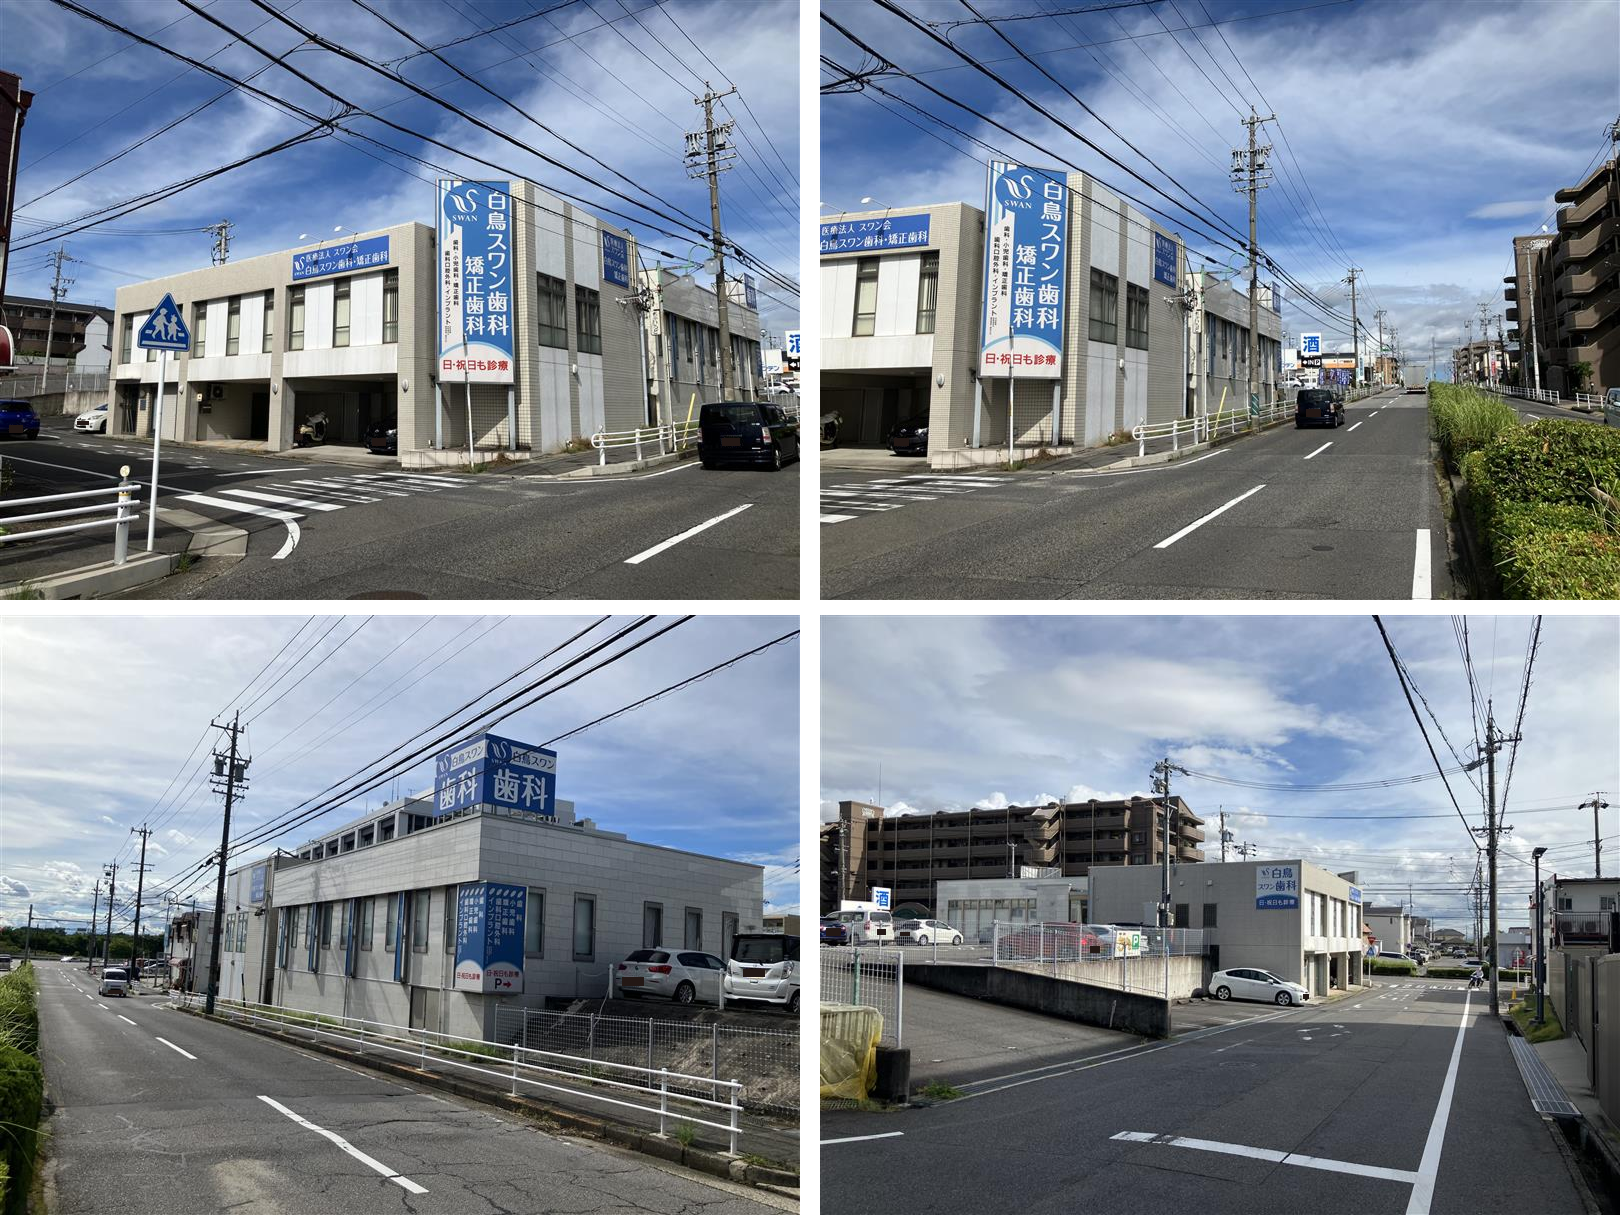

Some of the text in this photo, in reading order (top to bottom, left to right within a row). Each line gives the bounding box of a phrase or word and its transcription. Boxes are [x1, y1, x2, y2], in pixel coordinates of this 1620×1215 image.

[1004, 200, 1032, 208] SWAN
[859, 220, 892, 231] スワン会
[486, 190, 510, 336] 白鳥スワン歯科
[1036, 180, 1062, 330] 白鳥スワン歯科
[465, 255, 486, 335] 矯正歯科
[1013, 244, 1037, 328] 矯正歯科
[1303, 336, 1320, 353] 酒
[439, 767, 478, 811] 歯科
[493, 768, 548, 811] 歯科
[1272, 867, 1293, 879] 白鳥
[876, 890, 890, 907] 酒
[494, 978, 502, 990] P
